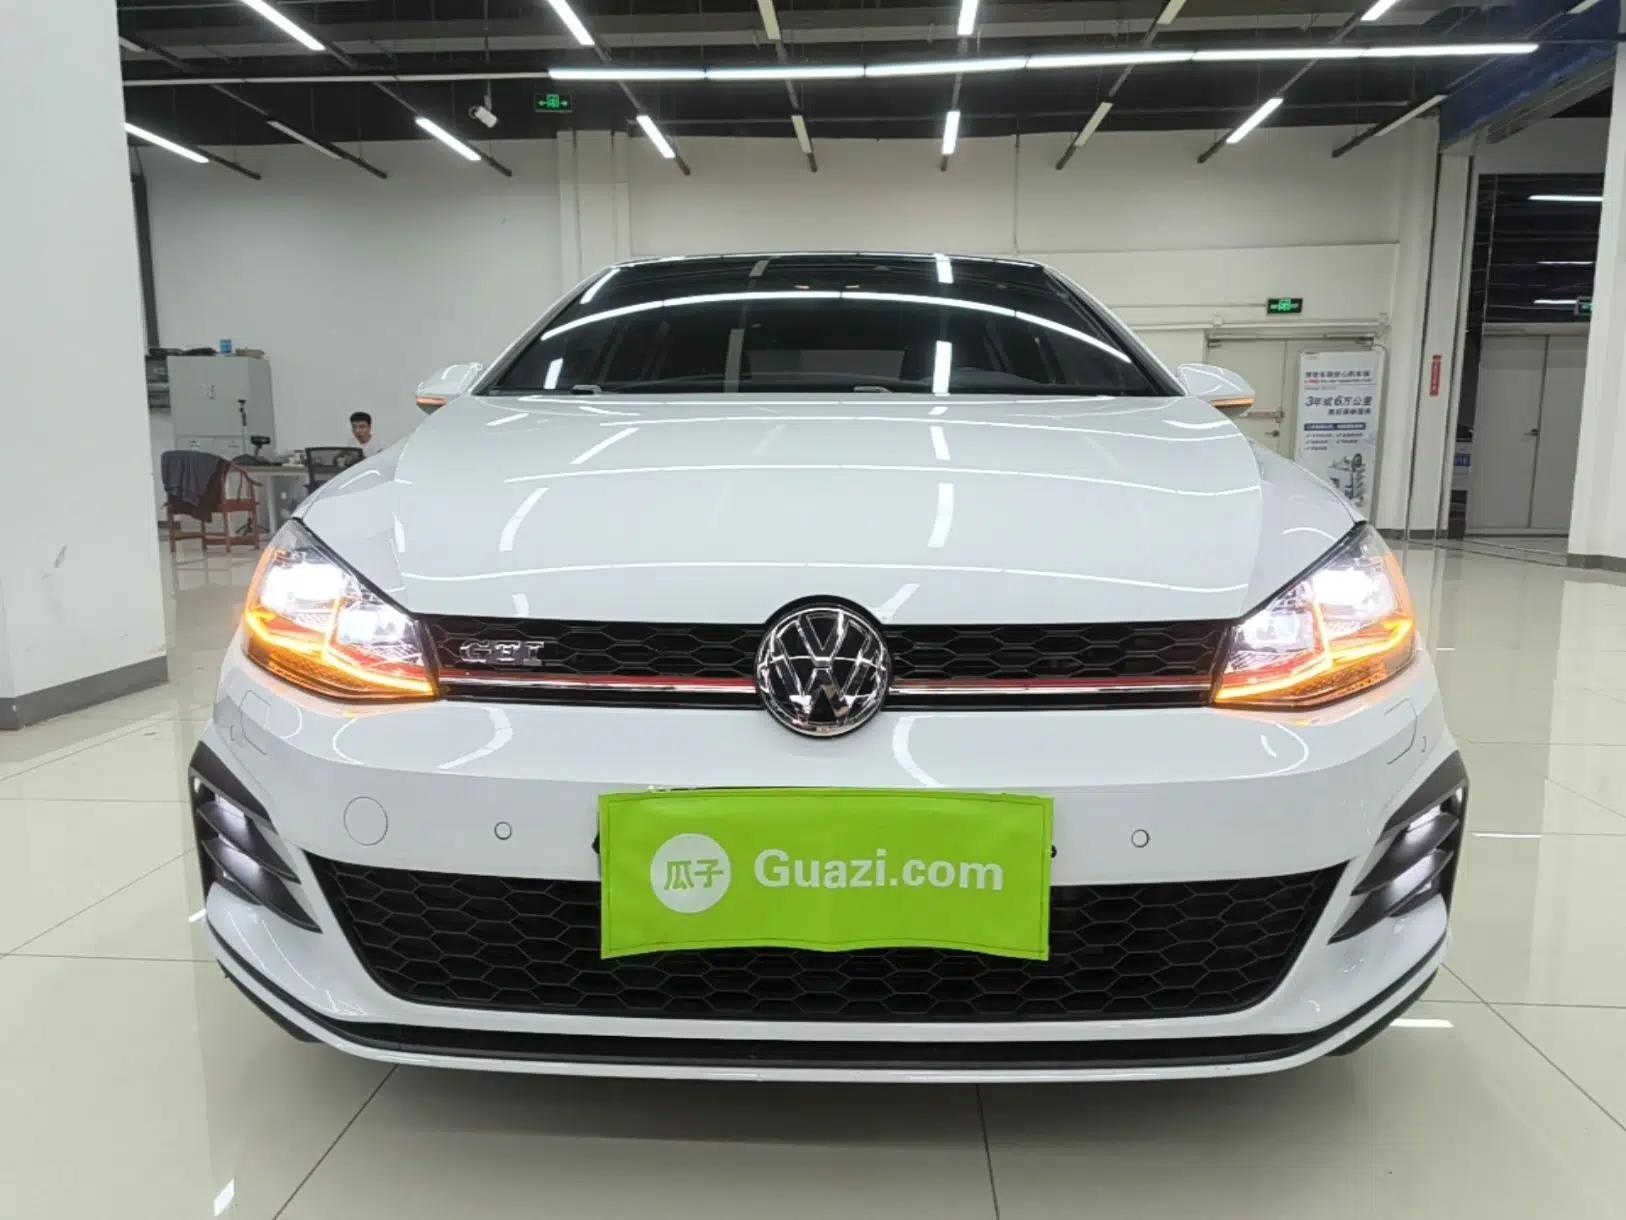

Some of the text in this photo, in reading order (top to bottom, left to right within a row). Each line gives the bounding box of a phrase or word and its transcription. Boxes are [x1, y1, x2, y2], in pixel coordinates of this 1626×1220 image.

[459, 639, 545, 667] GTI
[663, 858, 724, 891] 瓜子
[754, 848, 1004, 891] Guazi.com
